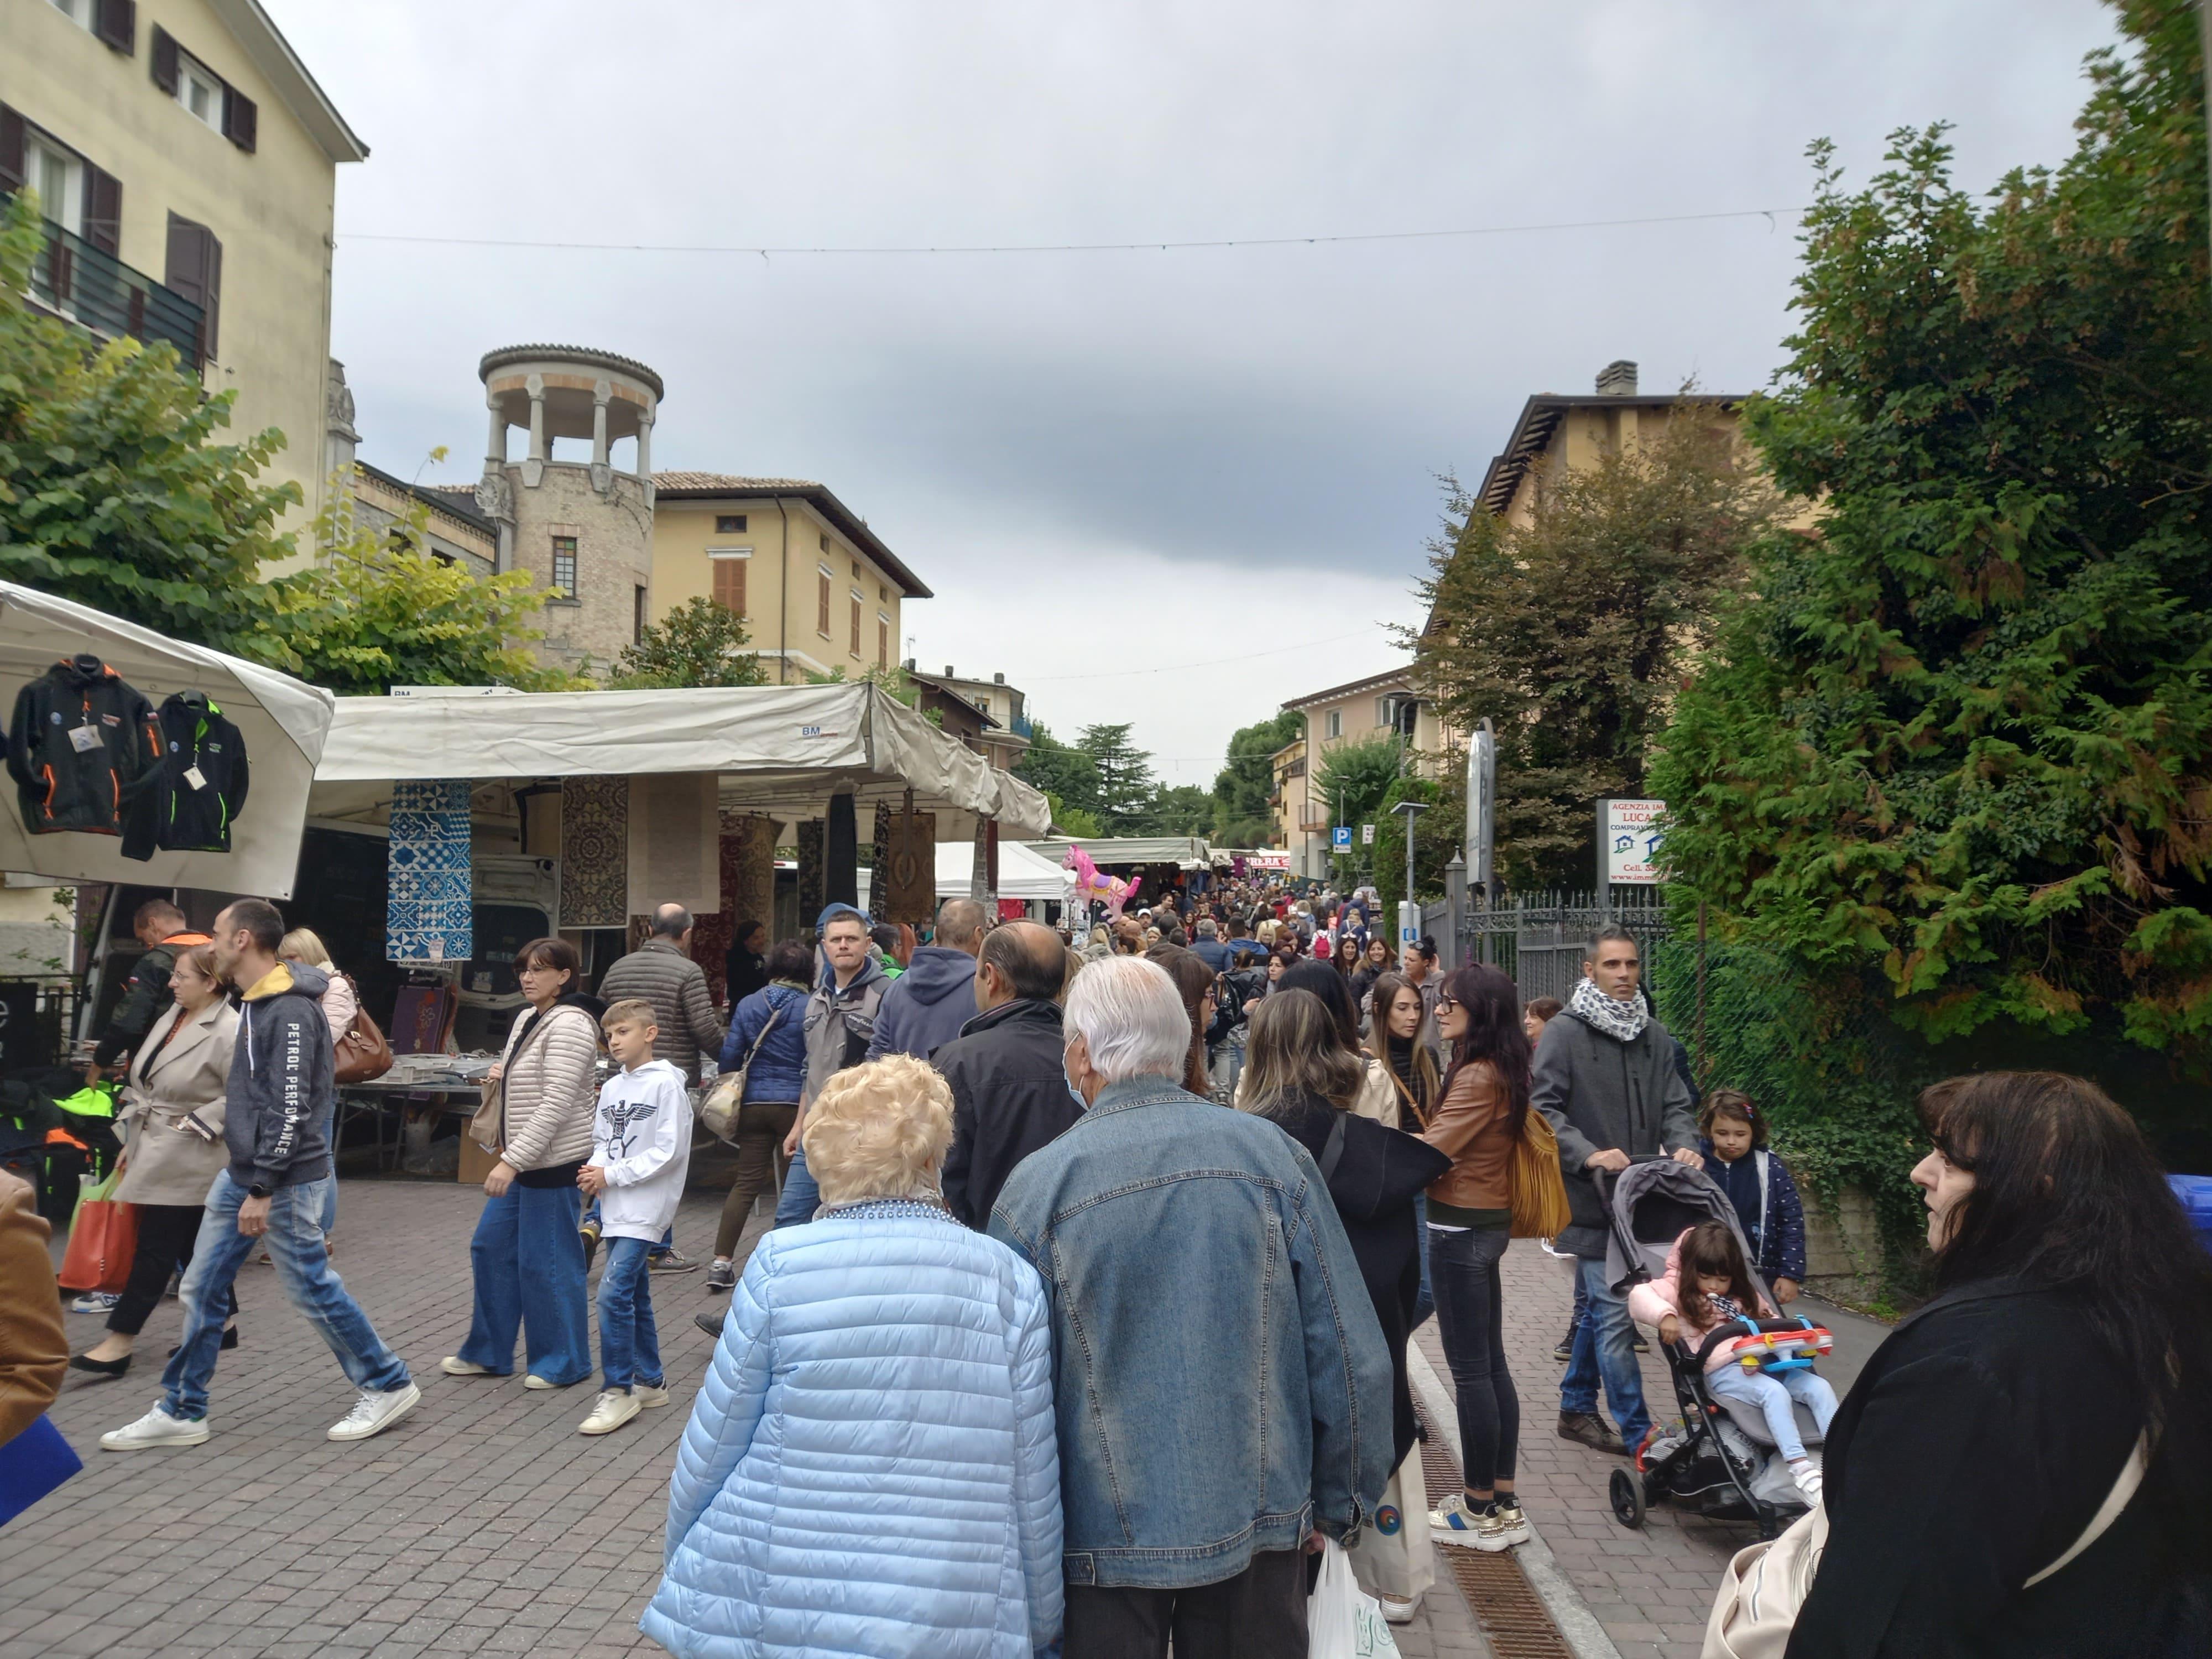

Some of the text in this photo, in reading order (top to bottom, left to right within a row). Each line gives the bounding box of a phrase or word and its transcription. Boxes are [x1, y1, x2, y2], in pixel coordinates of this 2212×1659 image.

[802, 727, 821, 735] BM
[1623, 813, 1651, 822] LUCA
[1337, 830, 1348, 843] P
[286, 1023, 300, 1071] PETROL
